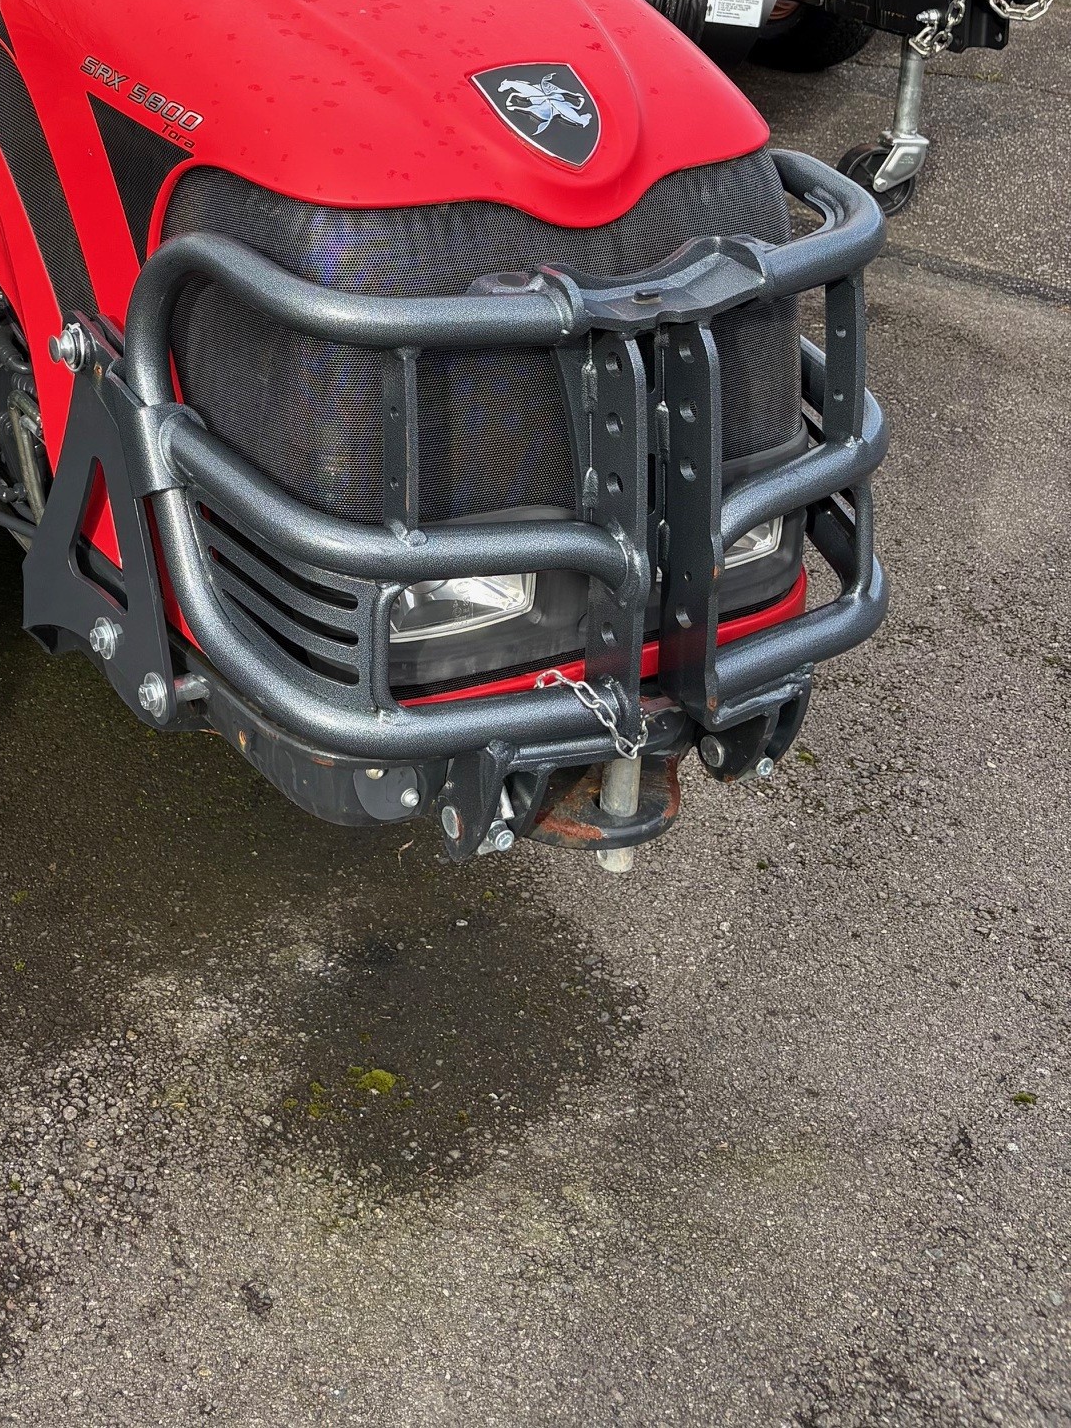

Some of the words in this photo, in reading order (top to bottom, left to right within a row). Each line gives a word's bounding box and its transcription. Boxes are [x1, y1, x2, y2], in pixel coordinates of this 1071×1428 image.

[79, 55, 131, 93] SRX
[126, 82, 205, 132] 5800
[160, 122, 196, 149] Tora
